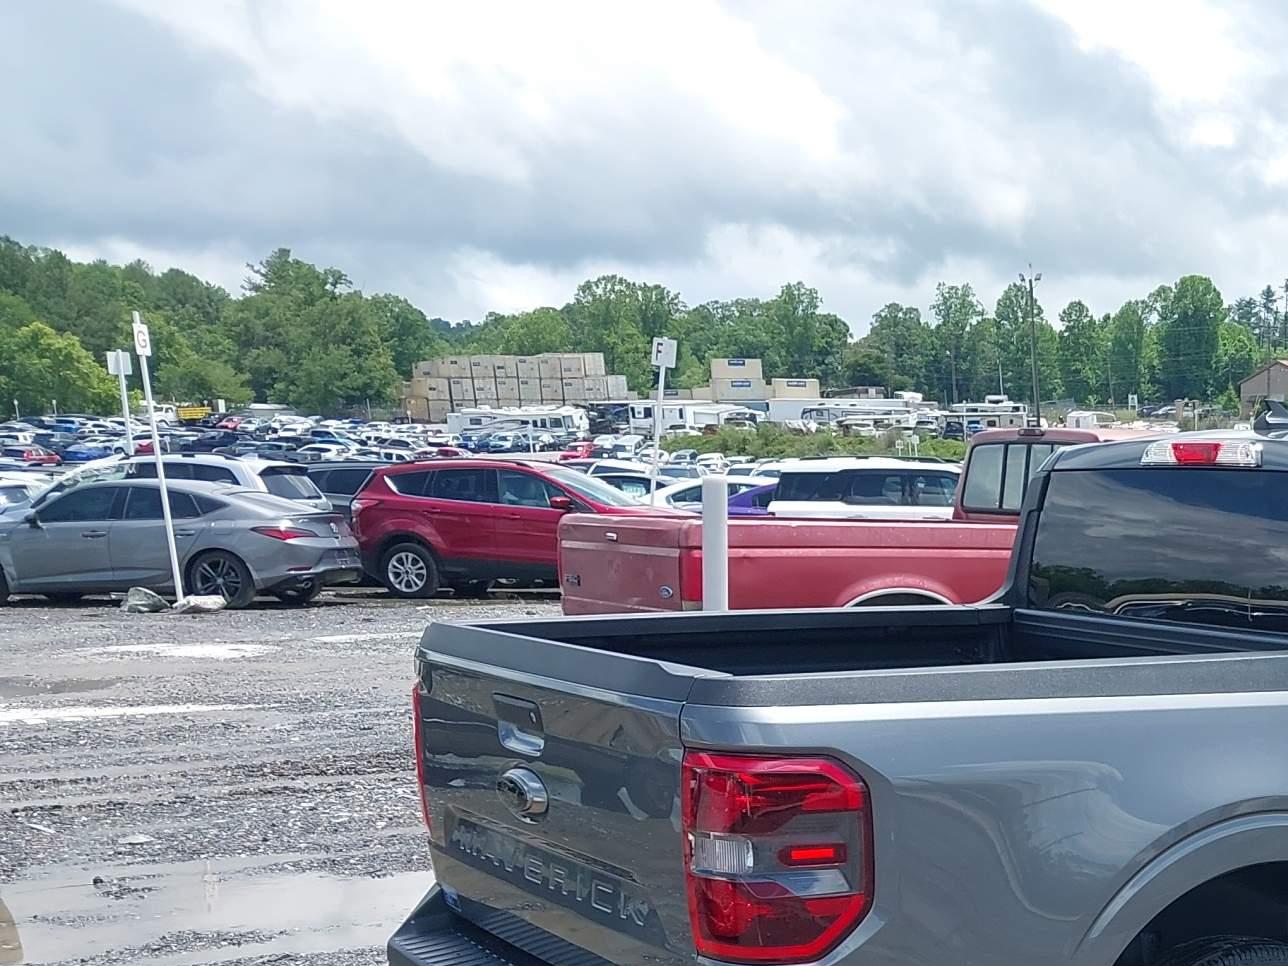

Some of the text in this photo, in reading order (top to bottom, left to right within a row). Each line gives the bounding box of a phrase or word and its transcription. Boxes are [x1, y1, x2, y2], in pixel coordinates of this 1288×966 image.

[136, 330, 148, 349] G
[655, 342, 664, 361] F
[453, 825, 649, 926] MAVERICK
